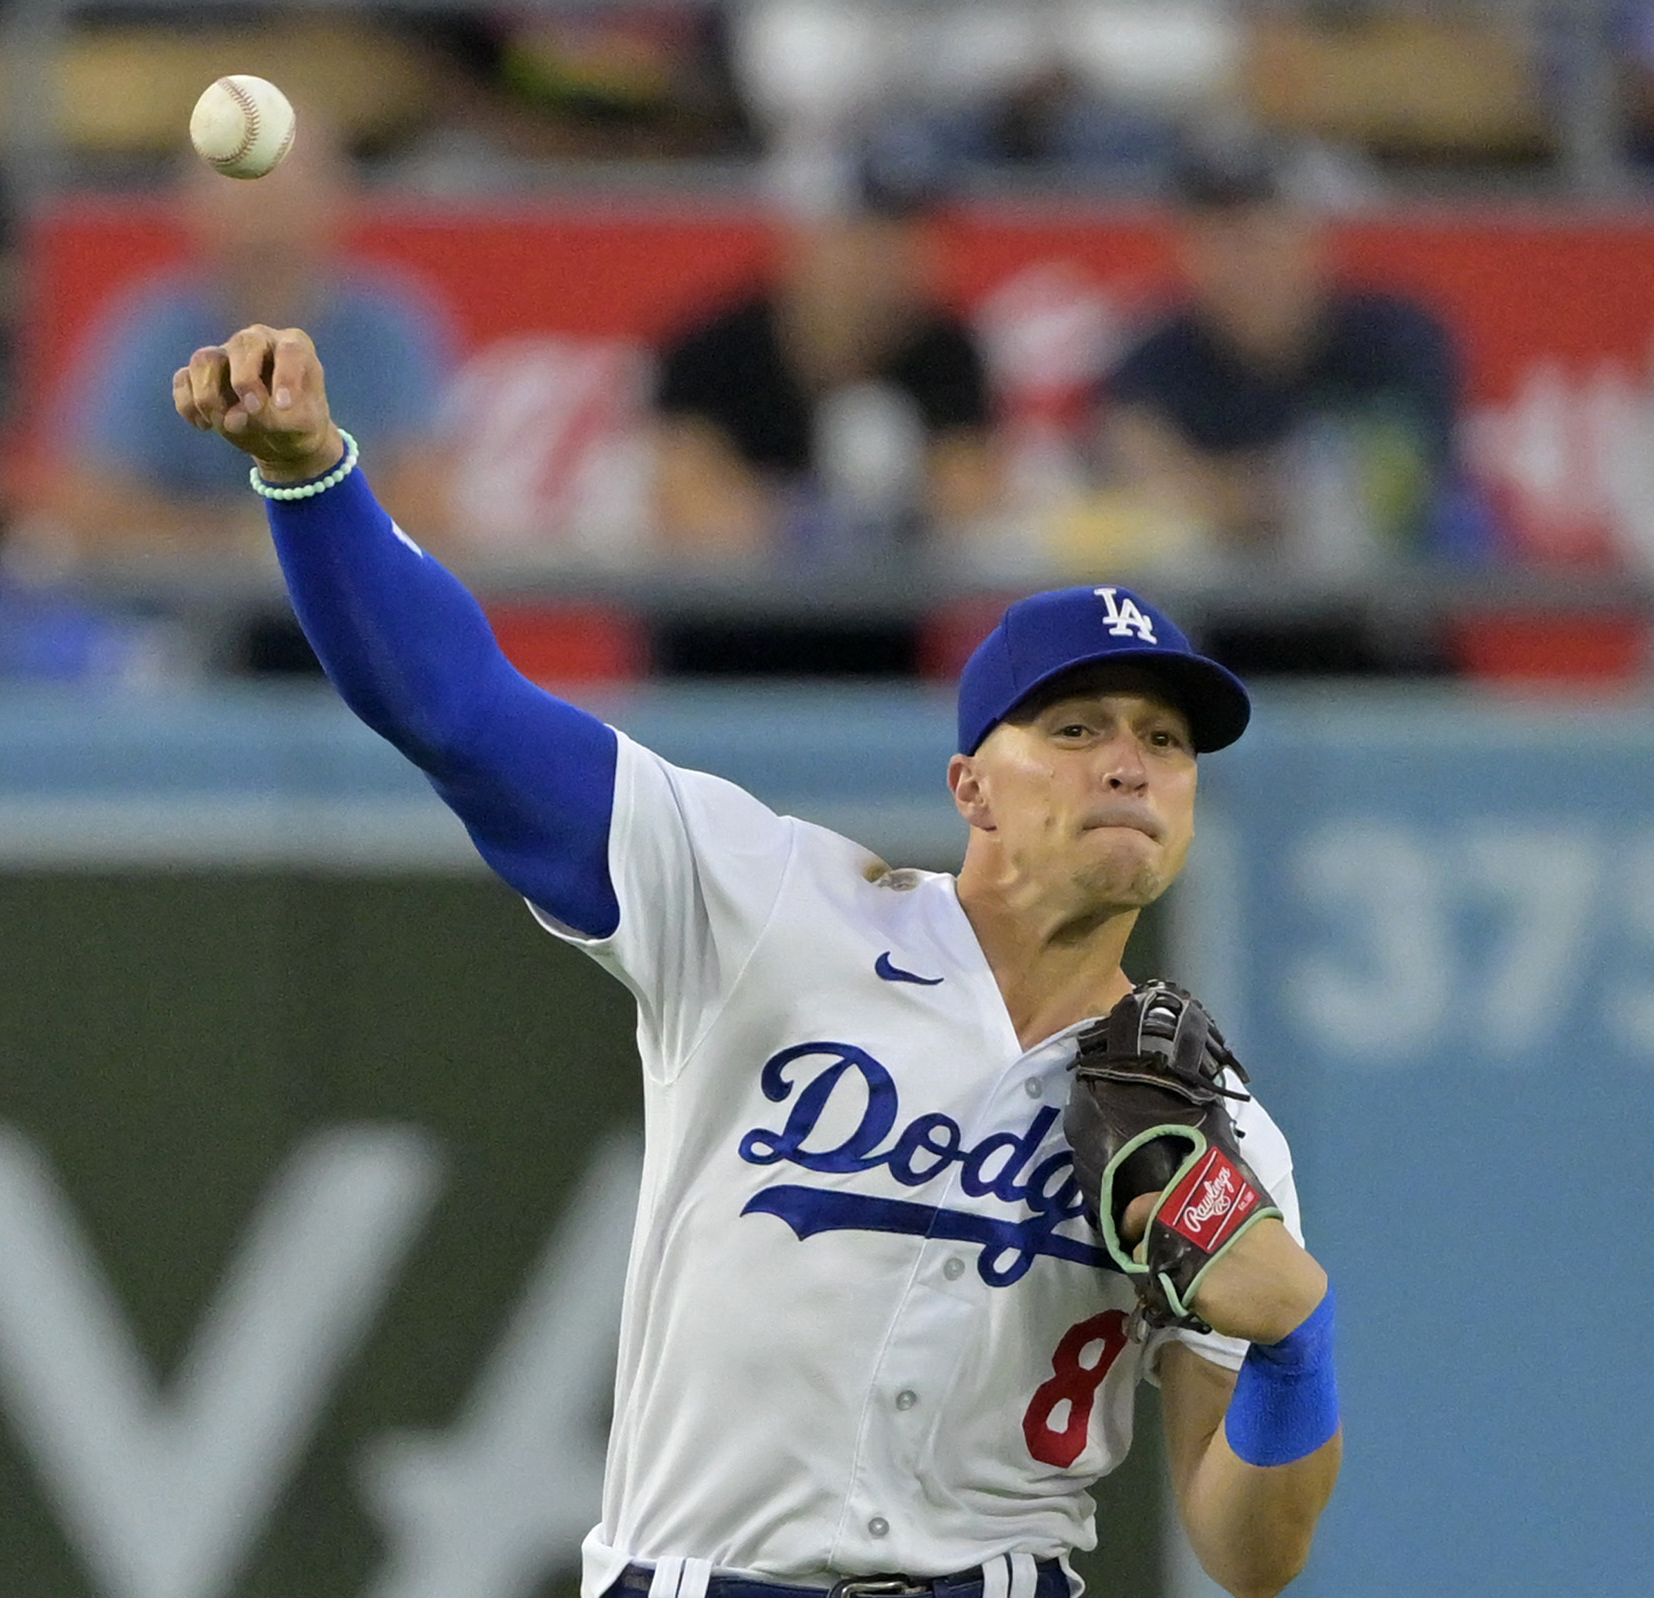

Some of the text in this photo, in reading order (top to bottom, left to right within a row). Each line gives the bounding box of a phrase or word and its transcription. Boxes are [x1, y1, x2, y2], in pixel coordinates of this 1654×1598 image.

[1093, 588, 1158, 645] LA
[1184, 1165, 1235, 1233] Rawlings
[1023, 1310, 1130, 1468] 8
